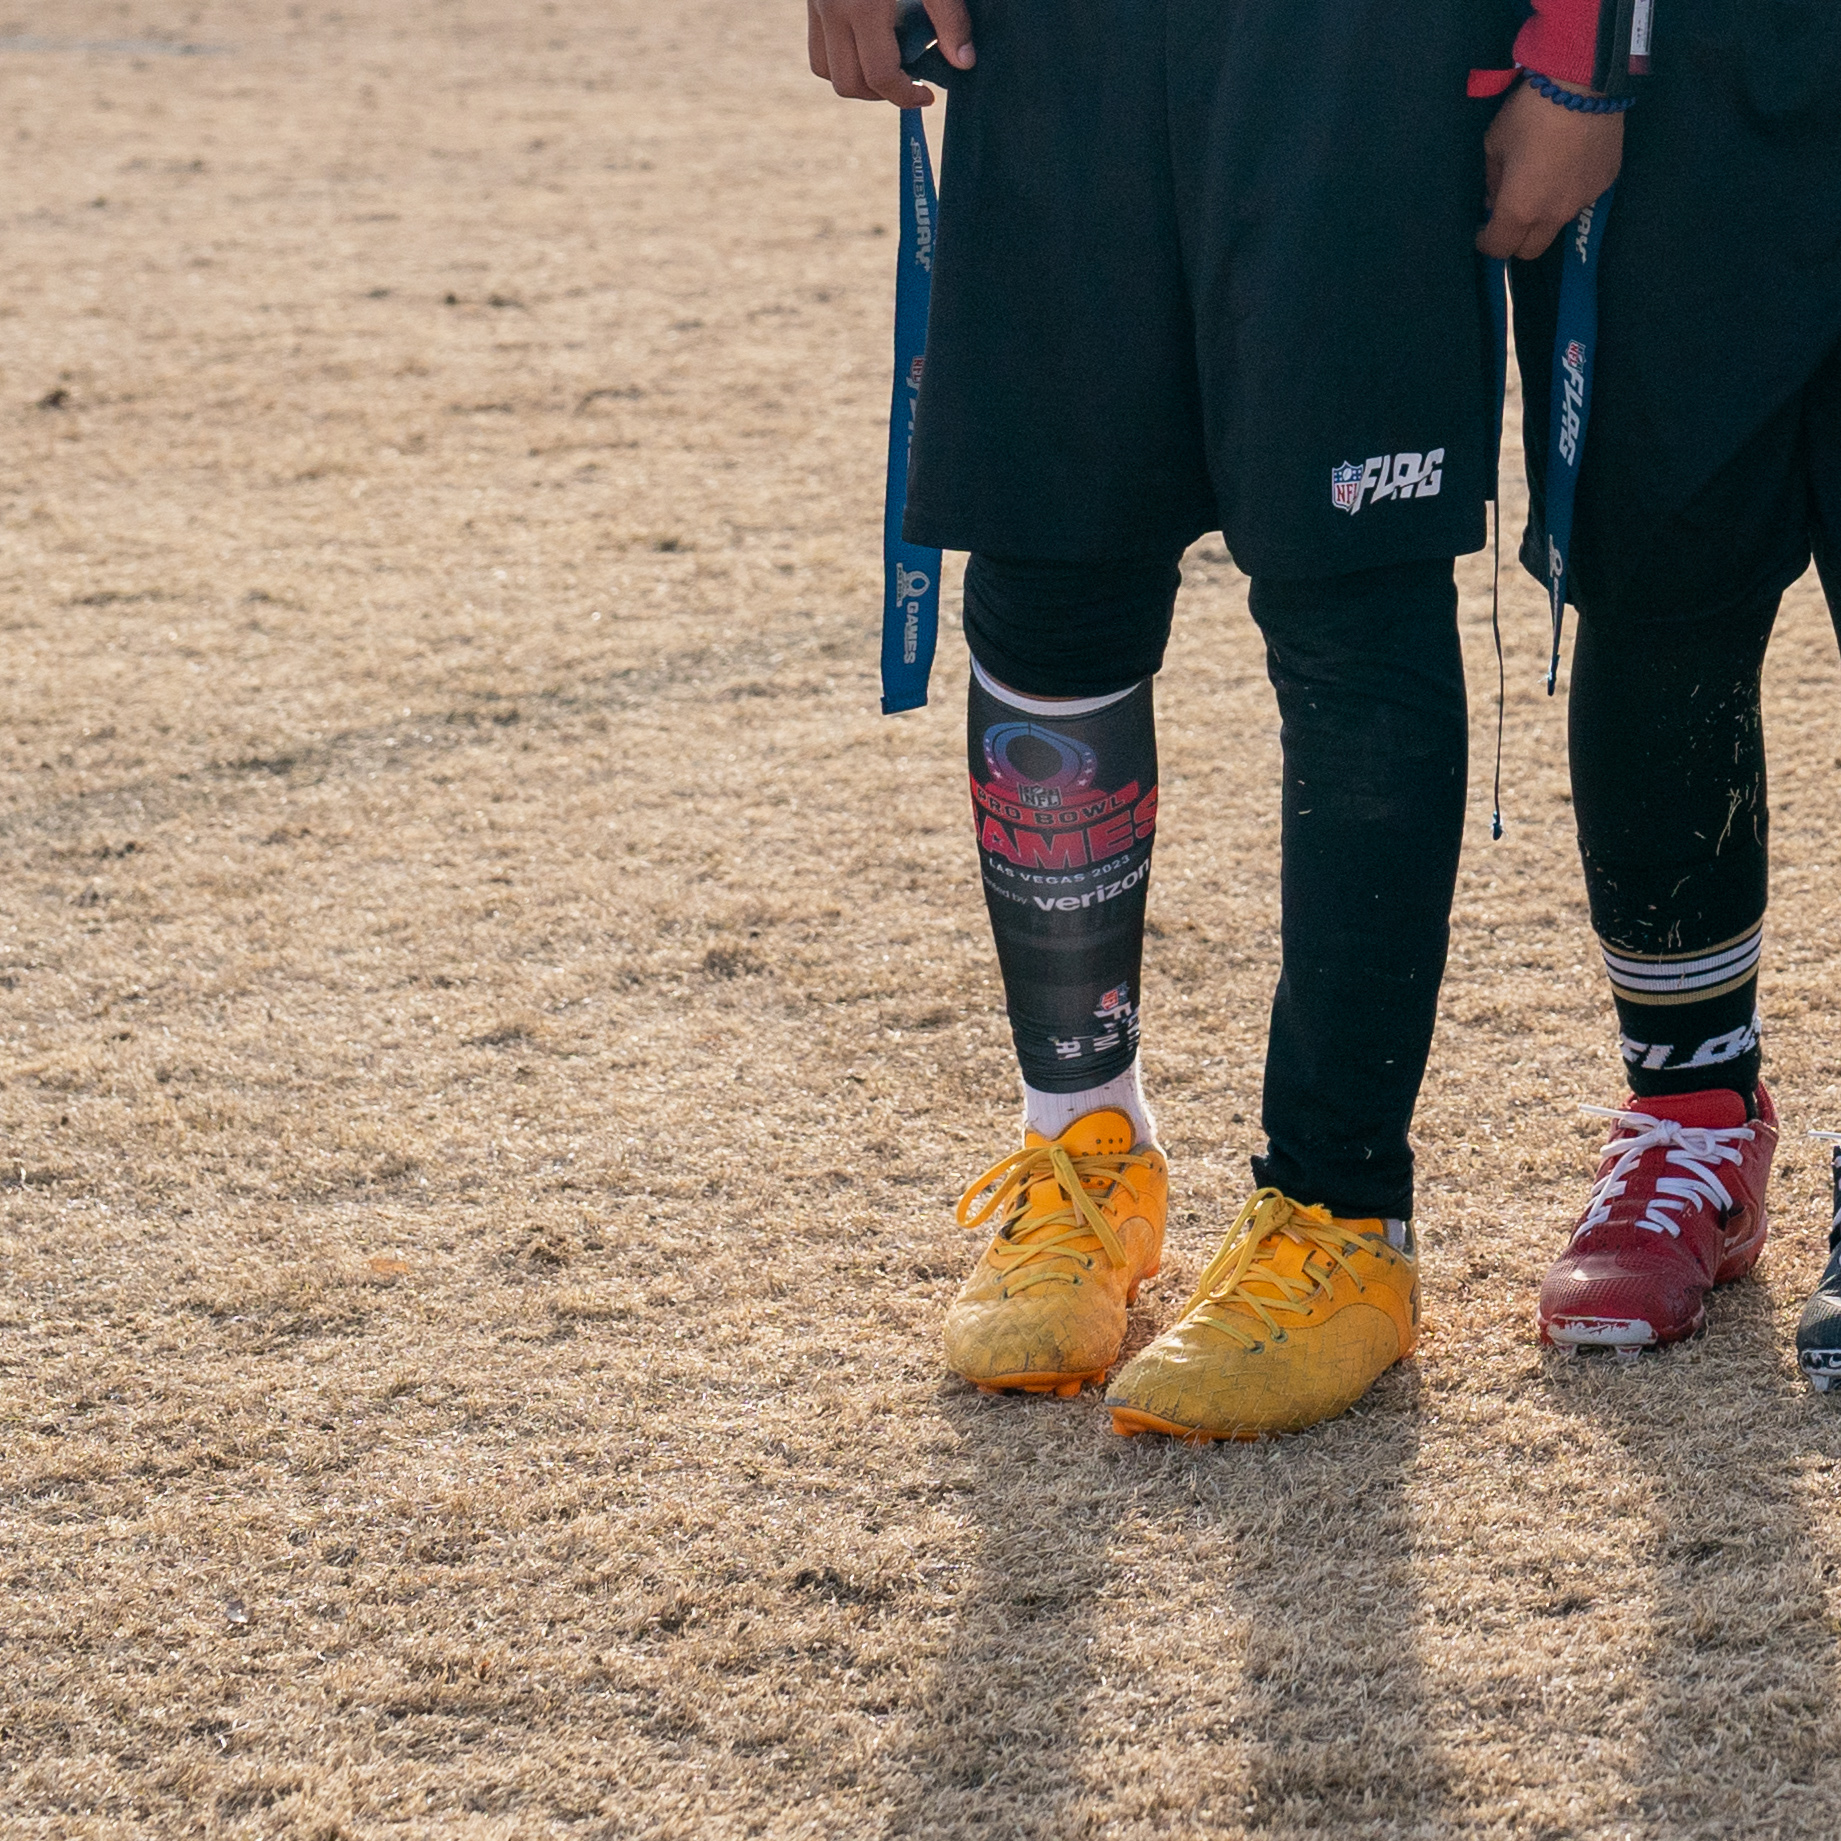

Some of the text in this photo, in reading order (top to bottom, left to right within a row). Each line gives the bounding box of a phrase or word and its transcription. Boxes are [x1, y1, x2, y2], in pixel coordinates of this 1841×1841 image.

[911, 136, 932, 272] SUBWAY
[1558, 359, 1584, 465] FLAG
[1351, 447, 1445, 516] FLAG
[903, 601, 919, 664] GAMES
[978, 788, 1125, 825] PRO BOWL
[1023, 794, 1060, 808] NFL
[989, 855, 1130, 886] LAS VEGAS 2023
[1033, 858, 1150, 912] verizon
